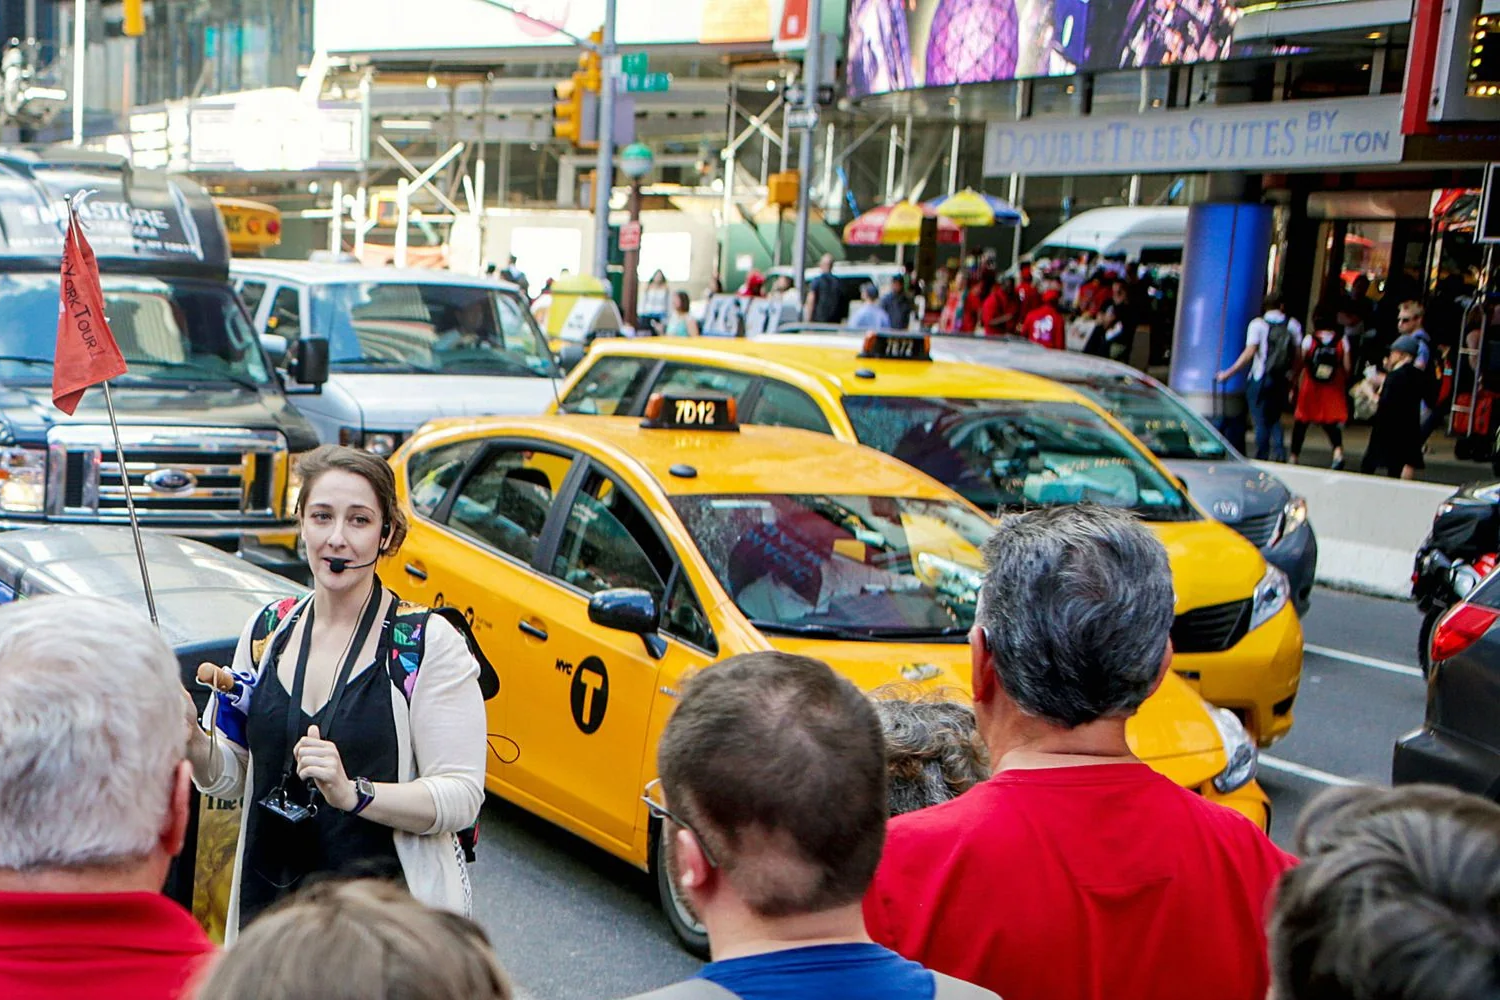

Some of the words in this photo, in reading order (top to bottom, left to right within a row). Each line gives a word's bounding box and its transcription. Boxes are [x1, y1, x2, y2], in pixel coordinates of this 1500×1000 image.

[1307, 109, 1340, 132] BY
[1304, 130, 1390, 155] HILTON
[63, 263, 82, 309] YORK
[74, 304, 99, 350] TOUR
[675, 399, 716, 425] 7D12
[555, 658, 574, 676] NYC
